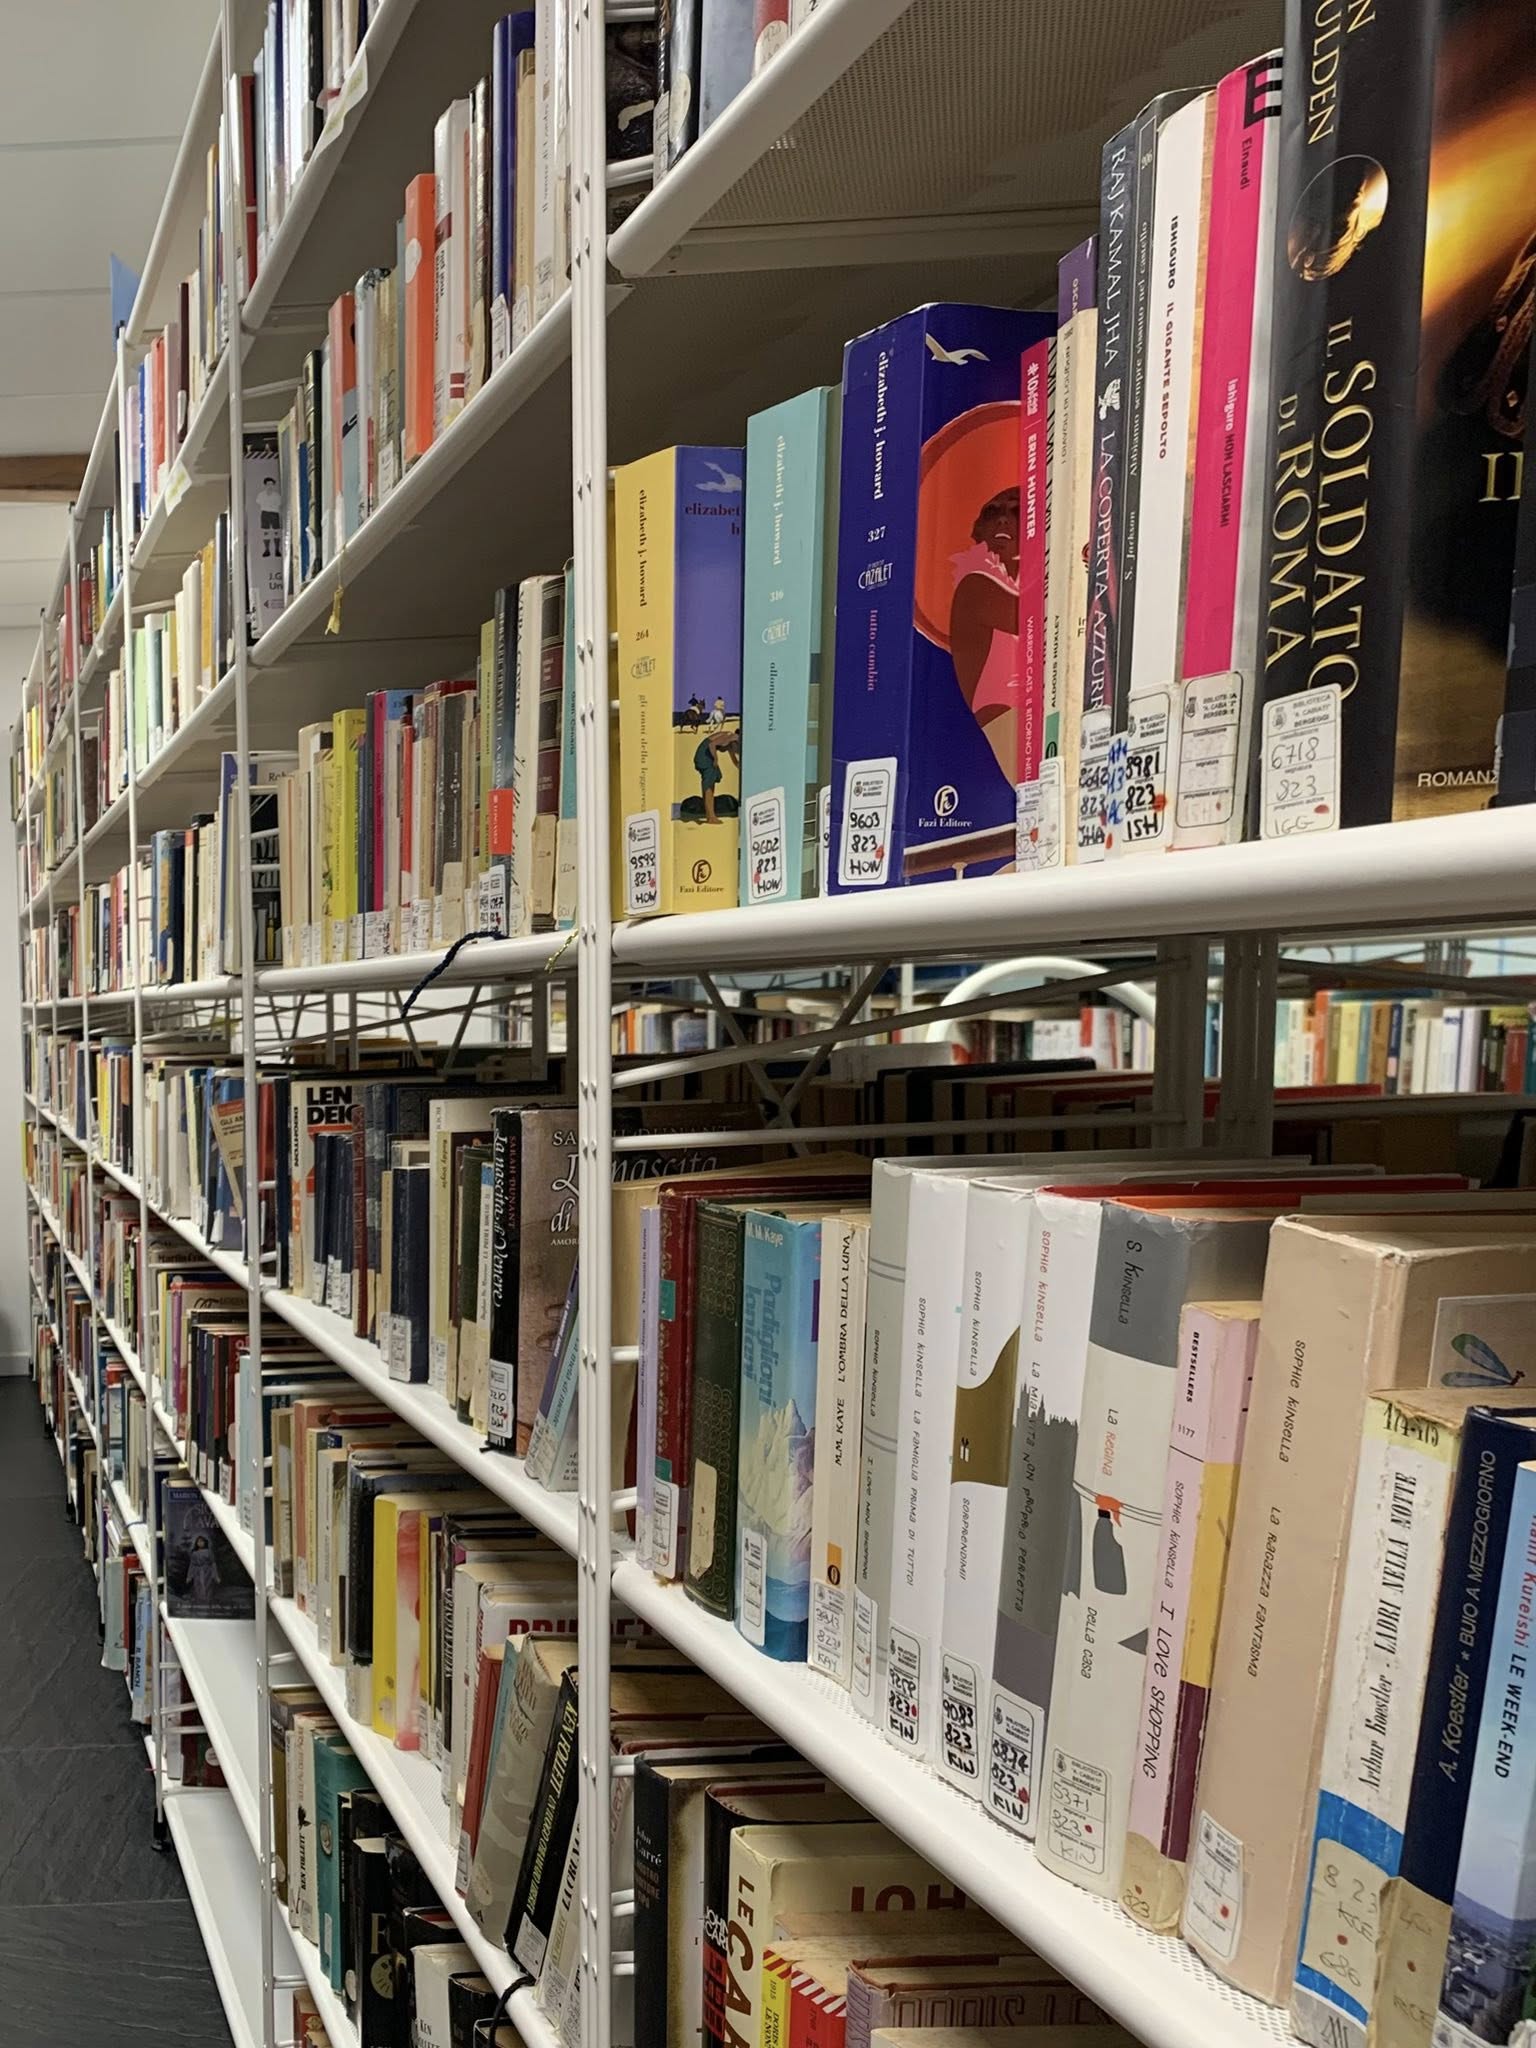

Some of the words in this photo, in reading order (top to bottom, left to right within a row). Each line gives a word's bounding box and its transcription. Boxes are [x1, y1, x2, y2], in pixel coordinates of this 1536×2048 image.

[1107, 145, 1126, 201] RAJ
[1239, 136, 1252, 190] Einaudi
[1105, 203, 1125, 311] KAMAL
[1167, 214, 1179, 290] ISHIGURO
[1165, 302, 1175, 318] IL
[1102, 312, 1122, 369] JHA
[1162, 319, 1175, 390] GIGANTE
[1326, 316, 1353, 358] IL
[876, 350, 889, 424] elizabeth
[1225, 378, 1238, 432] Ishiguro
[1159, 391, 1170, 460] SEPOLTO
[1276, 393, 1298, 435] DI
[873, 439, 886, 501] howard
[1026, 432, 1037, 471] ERIN
[1126, 510, 1136, 561] Jackson
[1134, 357, 1144, 411] sempre
[638, 488, 648, 547] elizabeth
[1025, 475, 1037, 541] HUNTER
[1308, 359, 1377, 701] SOLDATO
[867, 525, 886, 543] 327
[1093, 476, 1114, 600] COPERTA
[1264, 432, 1316, 674] ROMA
[639, 559, 648, 608] howard
[1270, 736, 1320, 770] 6718
[1125, 783, 1156, 813] 823
[1275, 774, 1318, 802] 823
[851, 834, 878, 854] 823
[918, 817, 938, 828] Fazi
[939, 817, 973, 828] Editore
[755, 856, 777, 874] 823
[756, 877, 782, 895] HOW
[849, 859, 882, 876] HOW
[679, 885, 695, 894] Fazi
[696, 884, 725, 894] Editore
[306, 1086, 353, 1105] LEN
[494, 1155, 509, 1223] nascita
[550, 1198, 576, 1234] di
[763, 1227, 785, 1249] Kaye
[841, 1235, 852, 1273] LUNA
[1126, 1239, 1143, 1254] S.
[493, 1235, 509, 1308] Venere
[840, 1273, 850, 1321] DELLA
[758, 1271, 783, 1411] Padiglioni
[1186, 1331, 1200, 1404] BESTSELLERS
[836, 1397, 845, 1435] KAYE
[1177, 1423, 1196, 1439] 1177
[834, 1436, 843, 1467] M.M.
[1022, 1452, 1036, 1482] NON
[1389, 1471, 1418, 1530] NOTTE
[1466, 1449, 1497, 1584] MEZZOGIORNO
[1381, 1536, 1409, 1594] NELLA
[1159, 1600, 1176, 1621] I
[1467, 1586, 1481, 1601] A
[1514, 1570, 1536, 1649] Kureishi
[1373, 1598, 1402, 1655] LADRI
[1459, 1601, 1481, 1648] BUIO
[1509, 1652, 1528, 1679] LE
[564, 1700, 580, 1728] KEN
[1364, 1674, 1393, 1737] Koestler
[1441, 1664, 1471, 1755] Koestler
[944, 1722, 973, 1751] 823
[1494, 1682, 1523, 1779] WEEK-END
[551, 1731, 572, 1798] FOLLETT
[946, 1750, 975, 1777] KIN
[991, 1761, 1017, 1794] 823
[1357, 1739, 1385, 1794] Arthur
[1438, 1758, 1459, 1784] A.
[992, 1790, 1024, 1822] KIN
[299, 1832, 307, 1872] FOLLETT
[738, 1874, 755, 1928] LE
[419, 2018, 433, 2036] KEN
